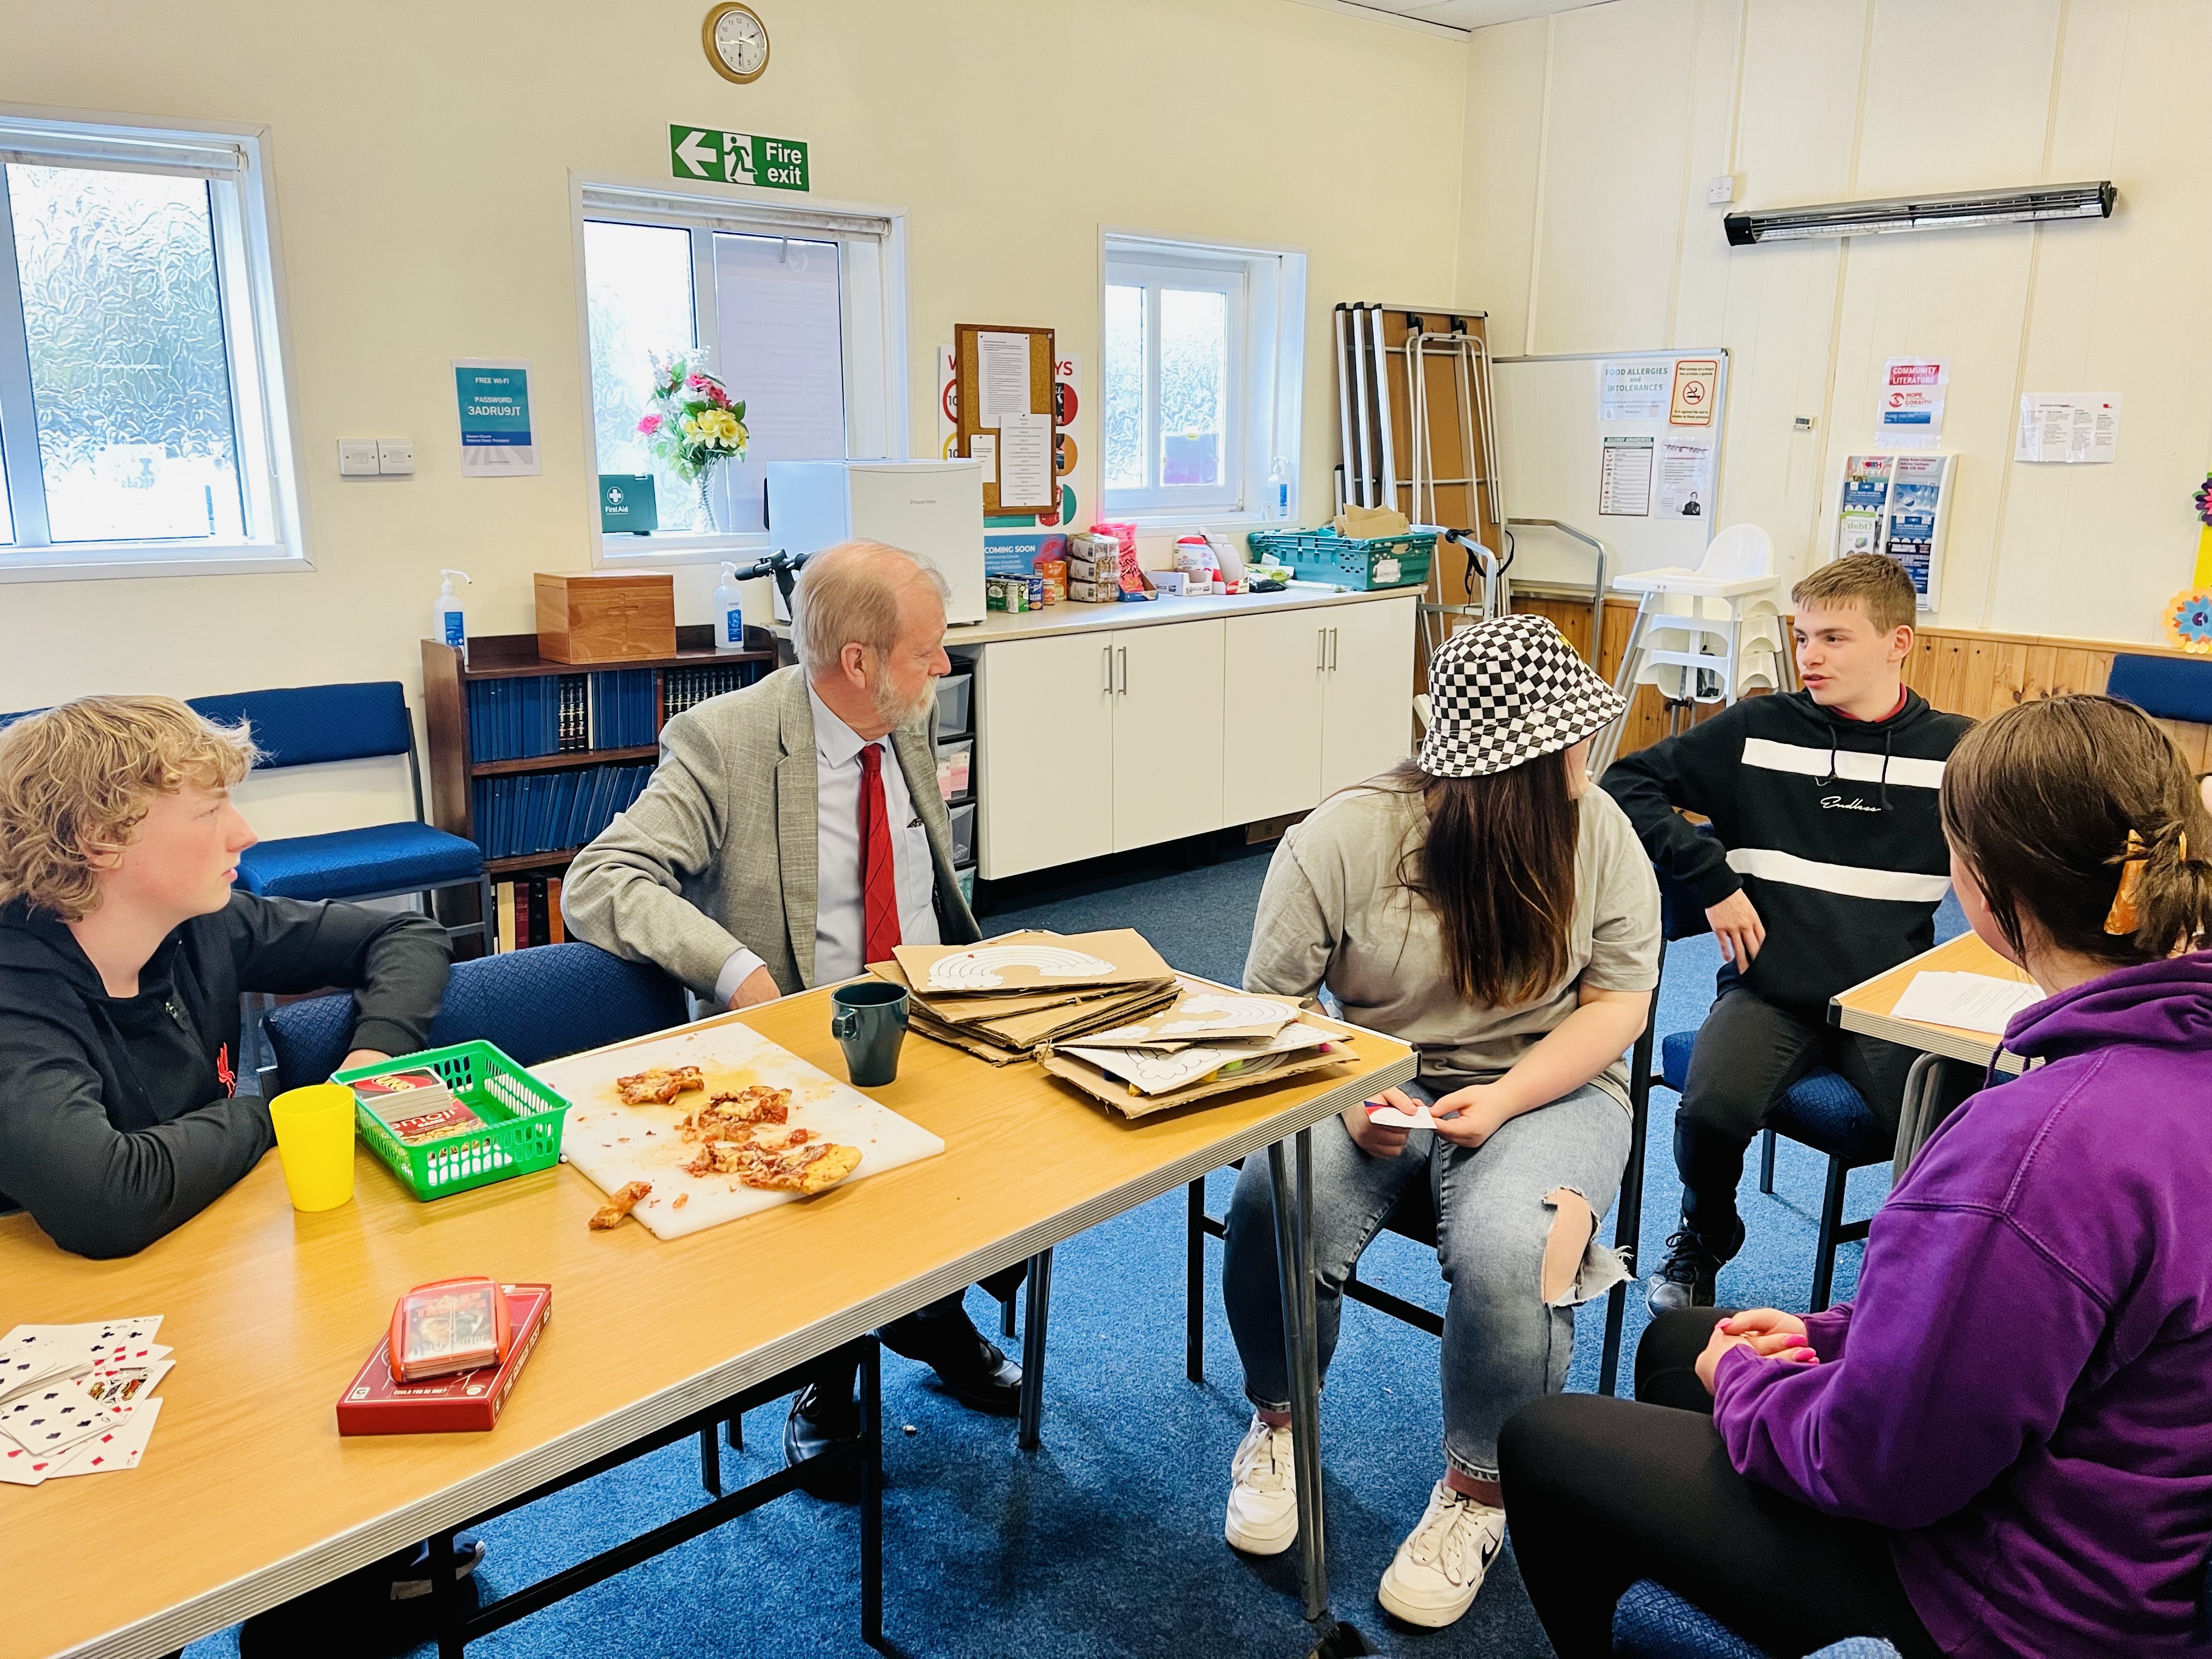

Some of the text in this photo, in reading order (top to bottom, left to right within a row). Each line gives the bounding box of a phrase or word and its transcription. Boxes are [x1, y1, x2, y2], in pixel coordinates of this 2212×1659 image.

[766, 142, 802, 165] Fire
[768, 166, 802, 185] exit
[1893, 366, 1937, 375] COMMUNITY
[1607, 384, 1663, 392] INTOLERANCES
[468, 406, 521, 416] 3ADRU9JT
[1848, 522, 1872, 531] debt?
[984, 545, 1036, 554] COMING SOON
[1820, 796, 1881, 812] Endless
[373, 1075, 416, 1092] UNO
[417, 1118, 447, 1128] GAME
